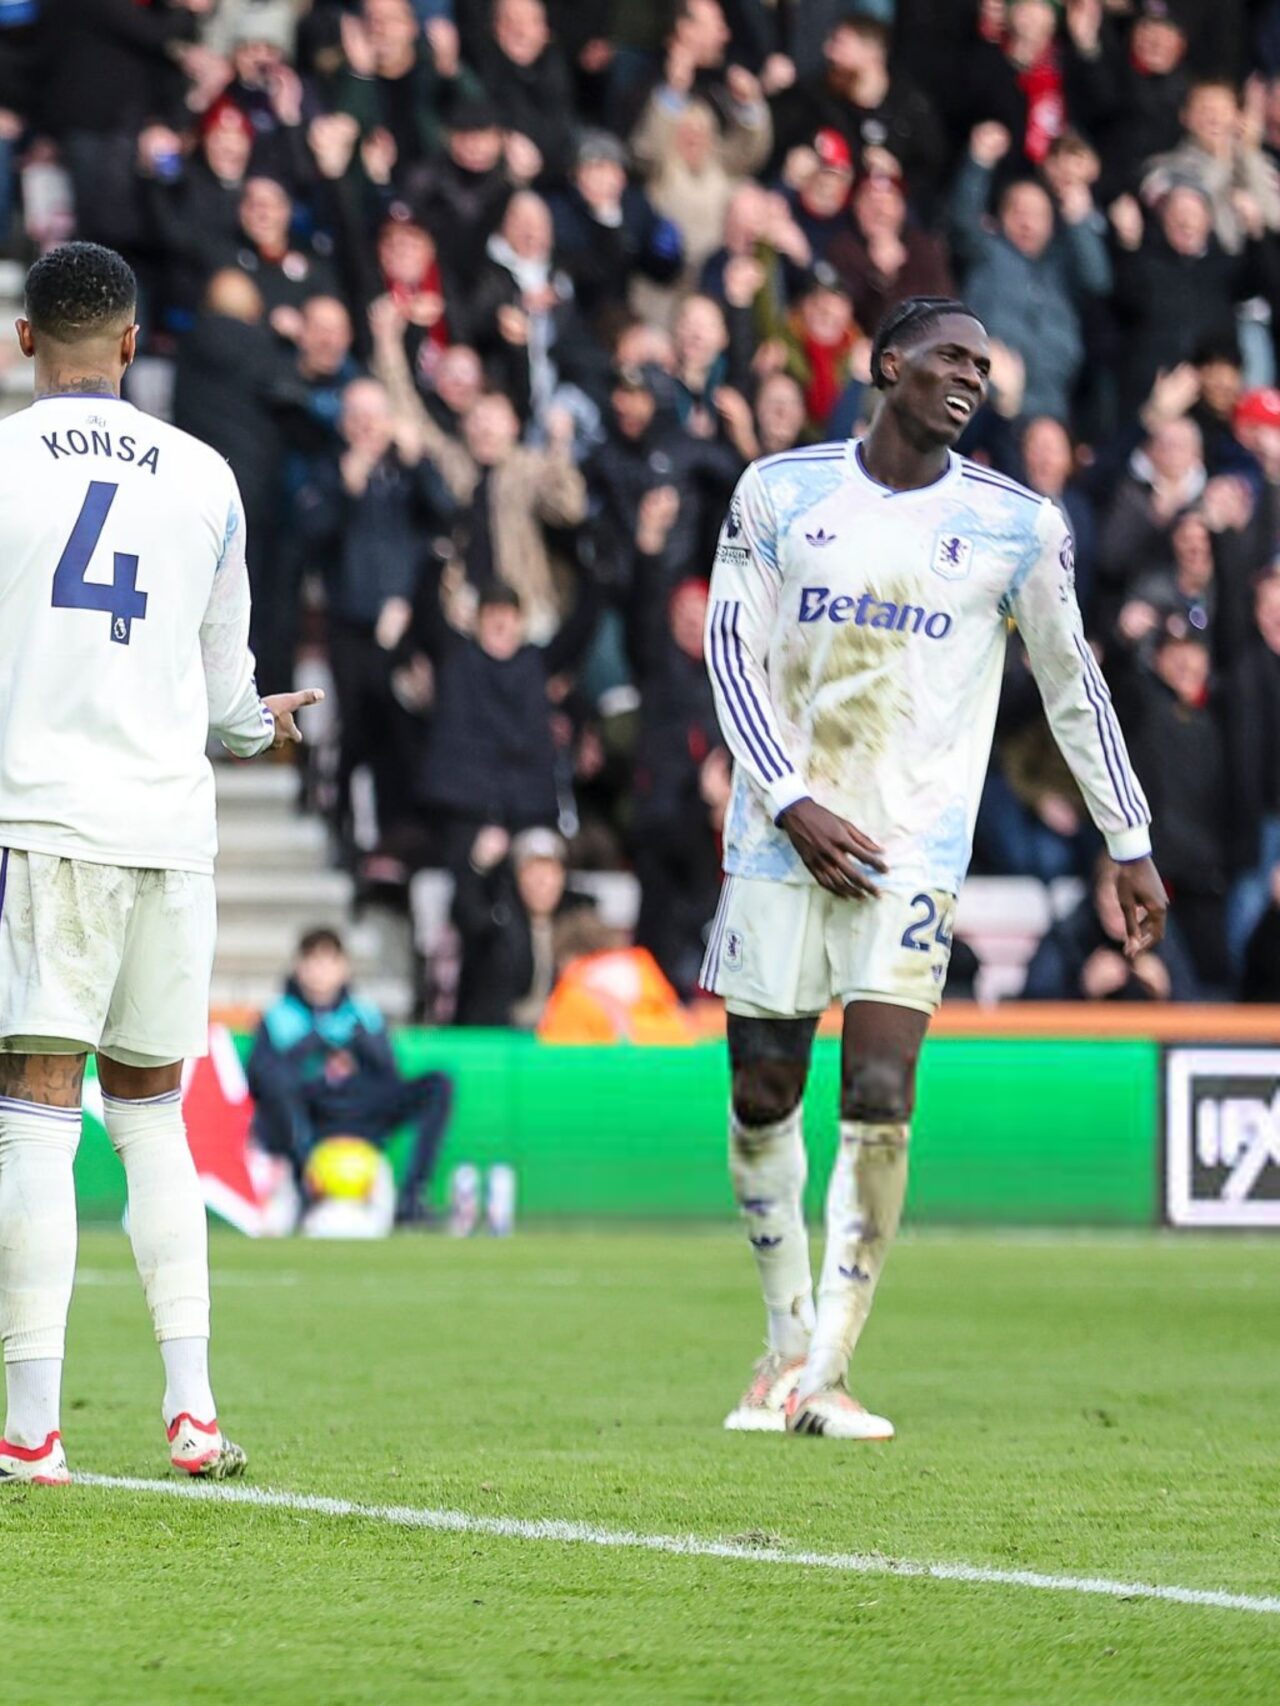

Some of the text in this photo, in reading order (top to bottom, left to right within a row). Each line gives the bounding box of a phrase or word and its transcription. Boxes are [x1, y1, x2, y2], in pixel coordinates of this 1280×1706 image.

[40, 429, 160, 476] KONSA
[50, 480, 149, 645] 4
[798, 586, 952, 640] Betano
